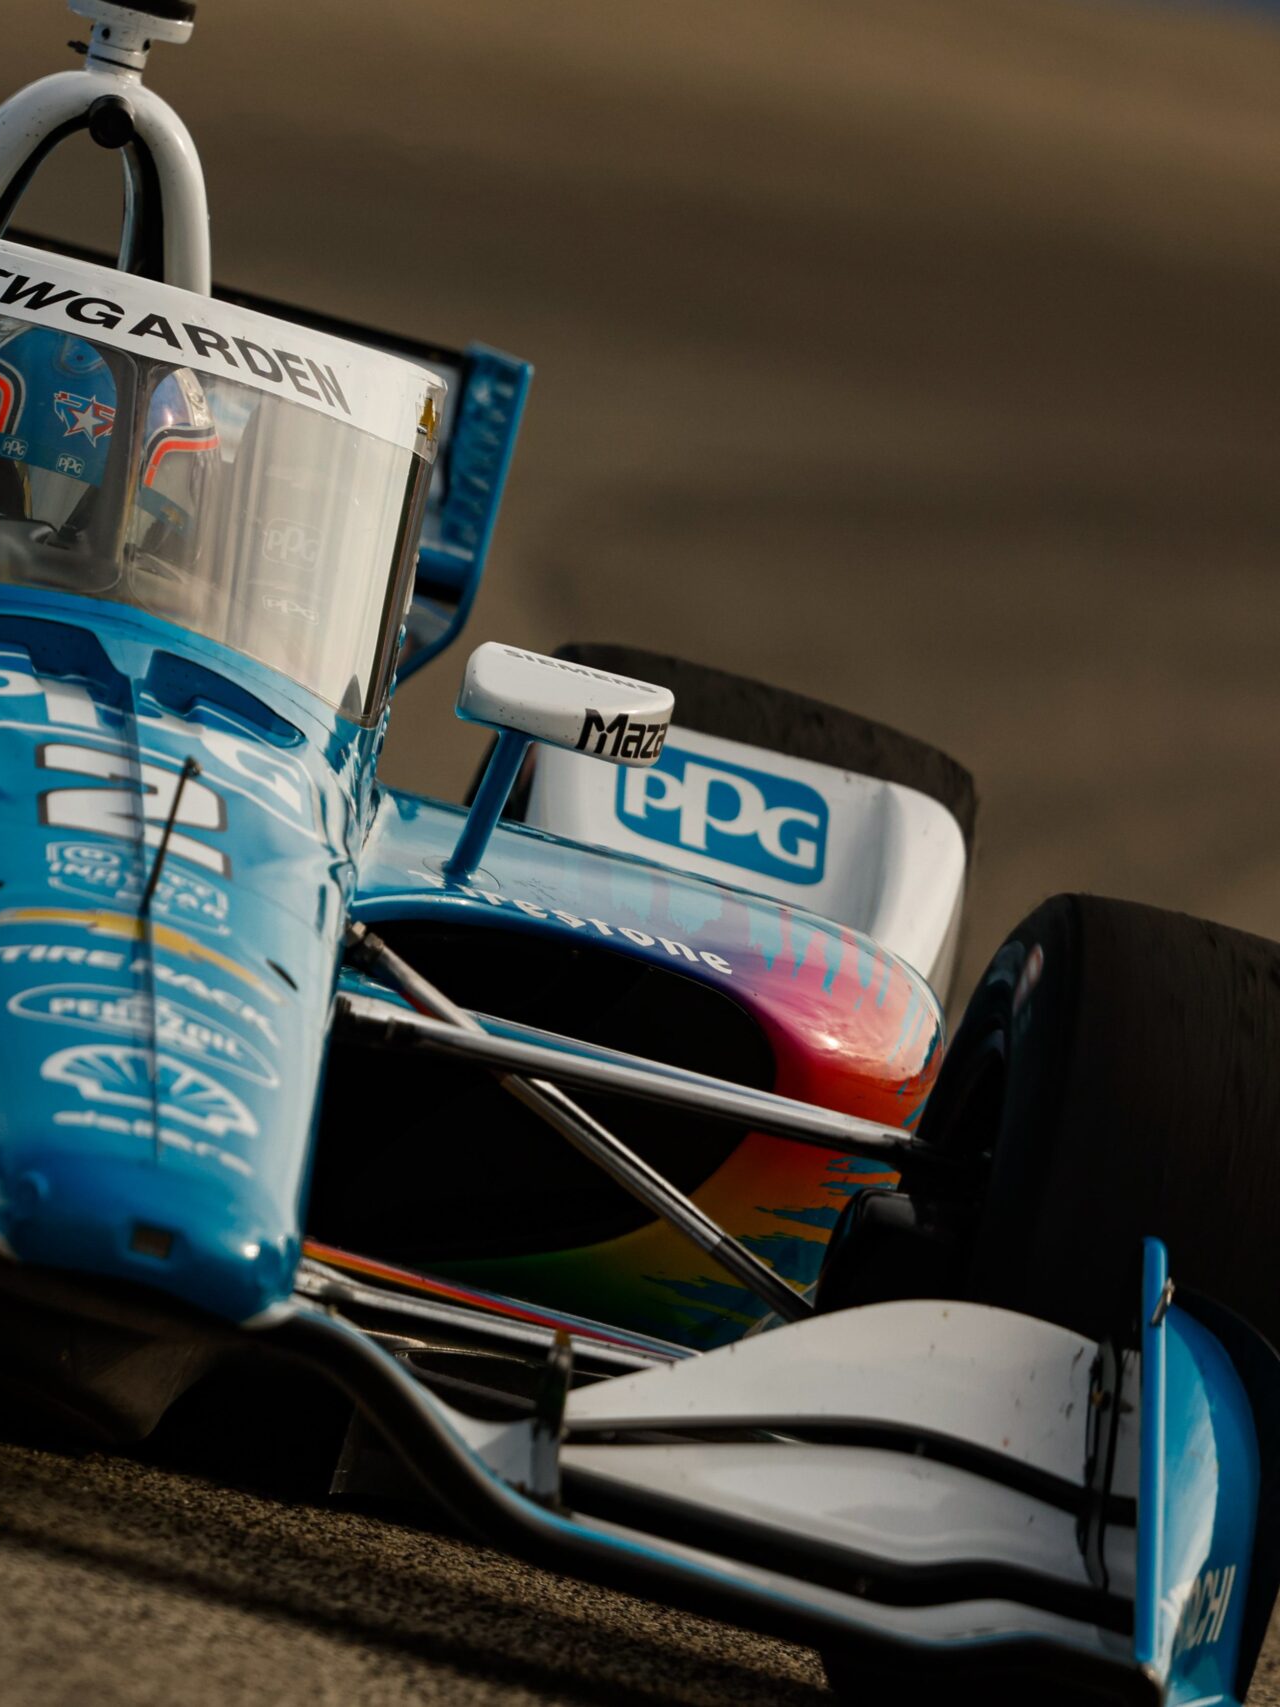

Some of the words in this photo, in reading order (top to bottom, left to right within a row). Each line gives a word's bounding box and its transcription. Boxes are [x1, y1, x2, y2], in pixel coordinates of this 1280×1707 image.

[3, 440, 26, 456] PPG
[58, 457, 82, 474] PPG
[504, 649, 657, 693] SIEMENS
[575, 708, 668, 759] Maza
[624, 761, 819, 869] PPG
